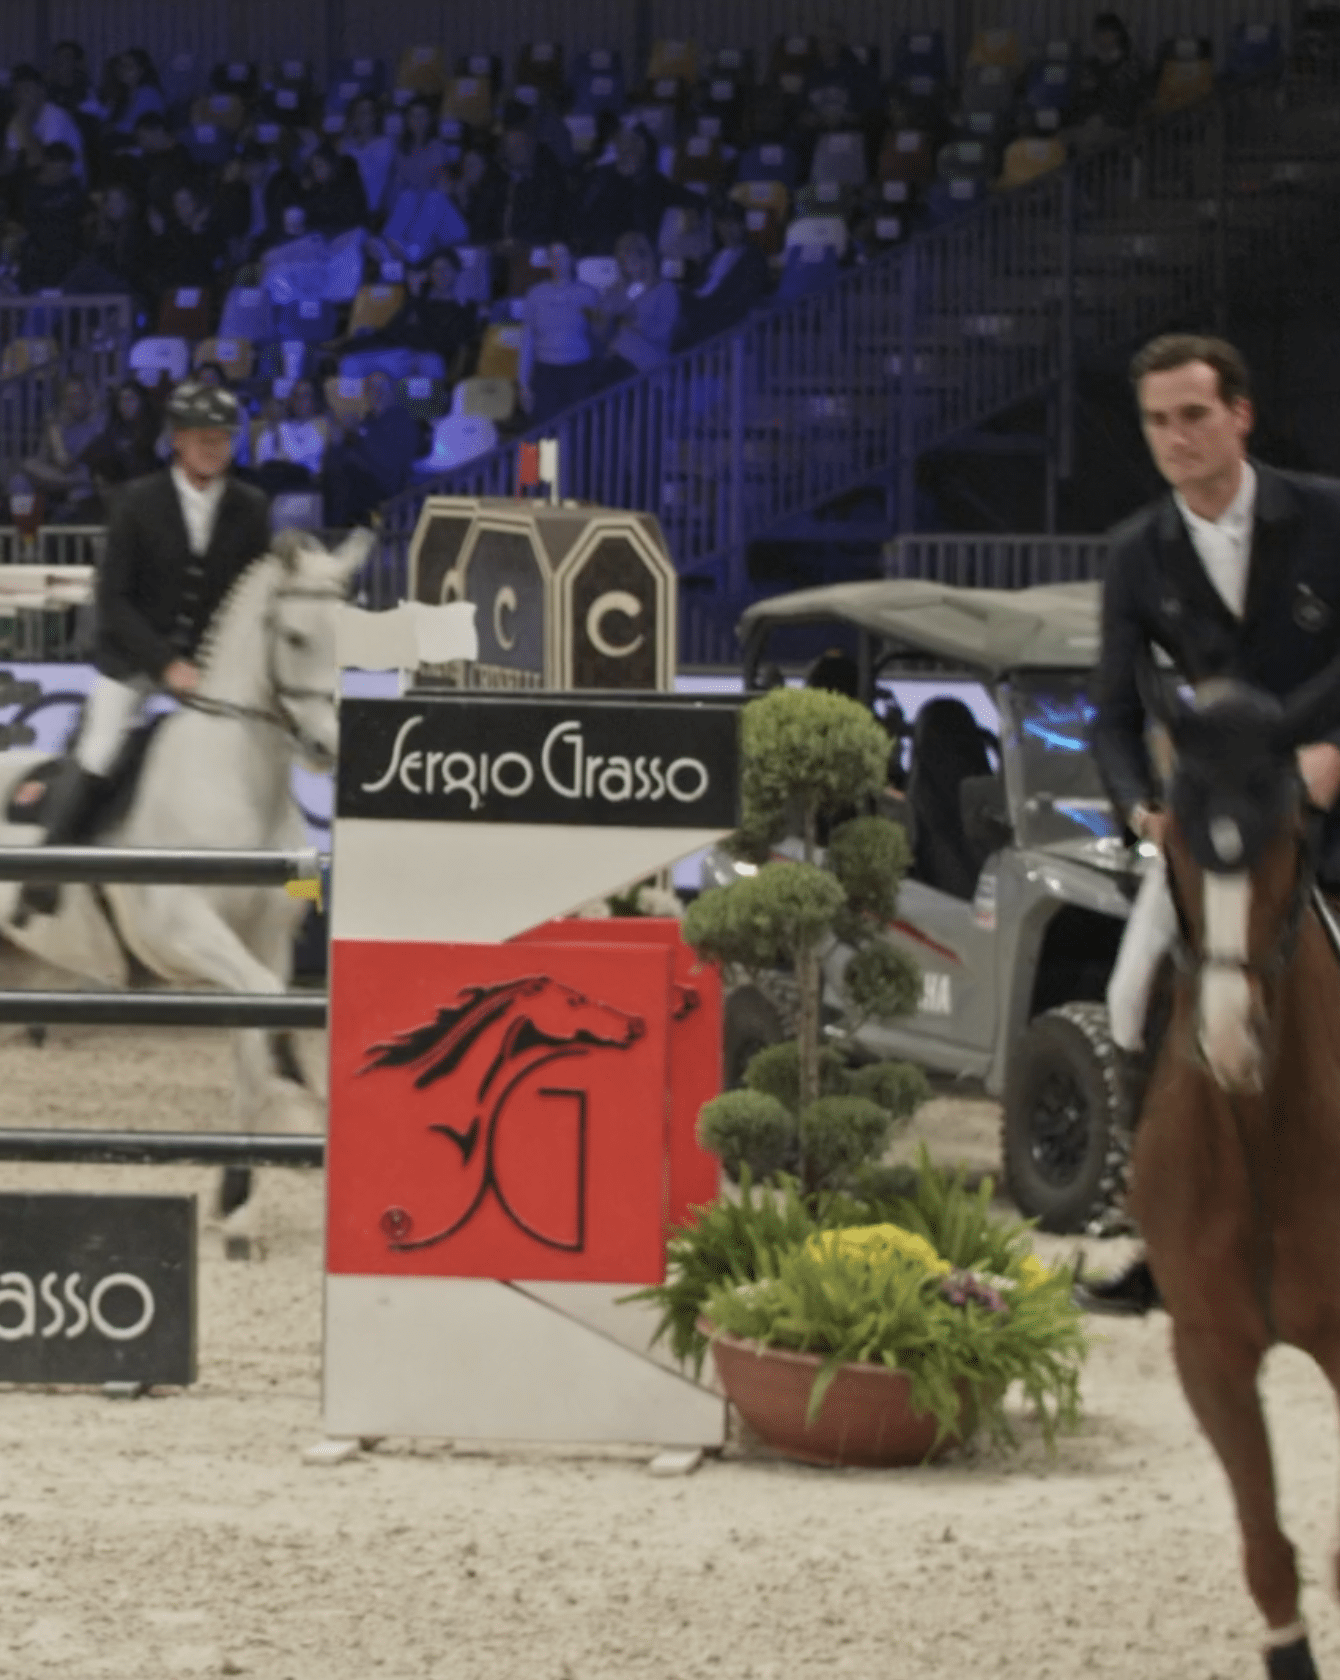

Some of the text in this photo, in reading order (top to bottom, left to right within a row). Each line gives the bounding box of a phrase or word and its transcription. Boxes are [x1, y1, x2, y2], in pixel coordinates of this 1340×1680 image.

[586, 590, 644, 657] C
[361, 715, 710, 811] Sergio Grasso
